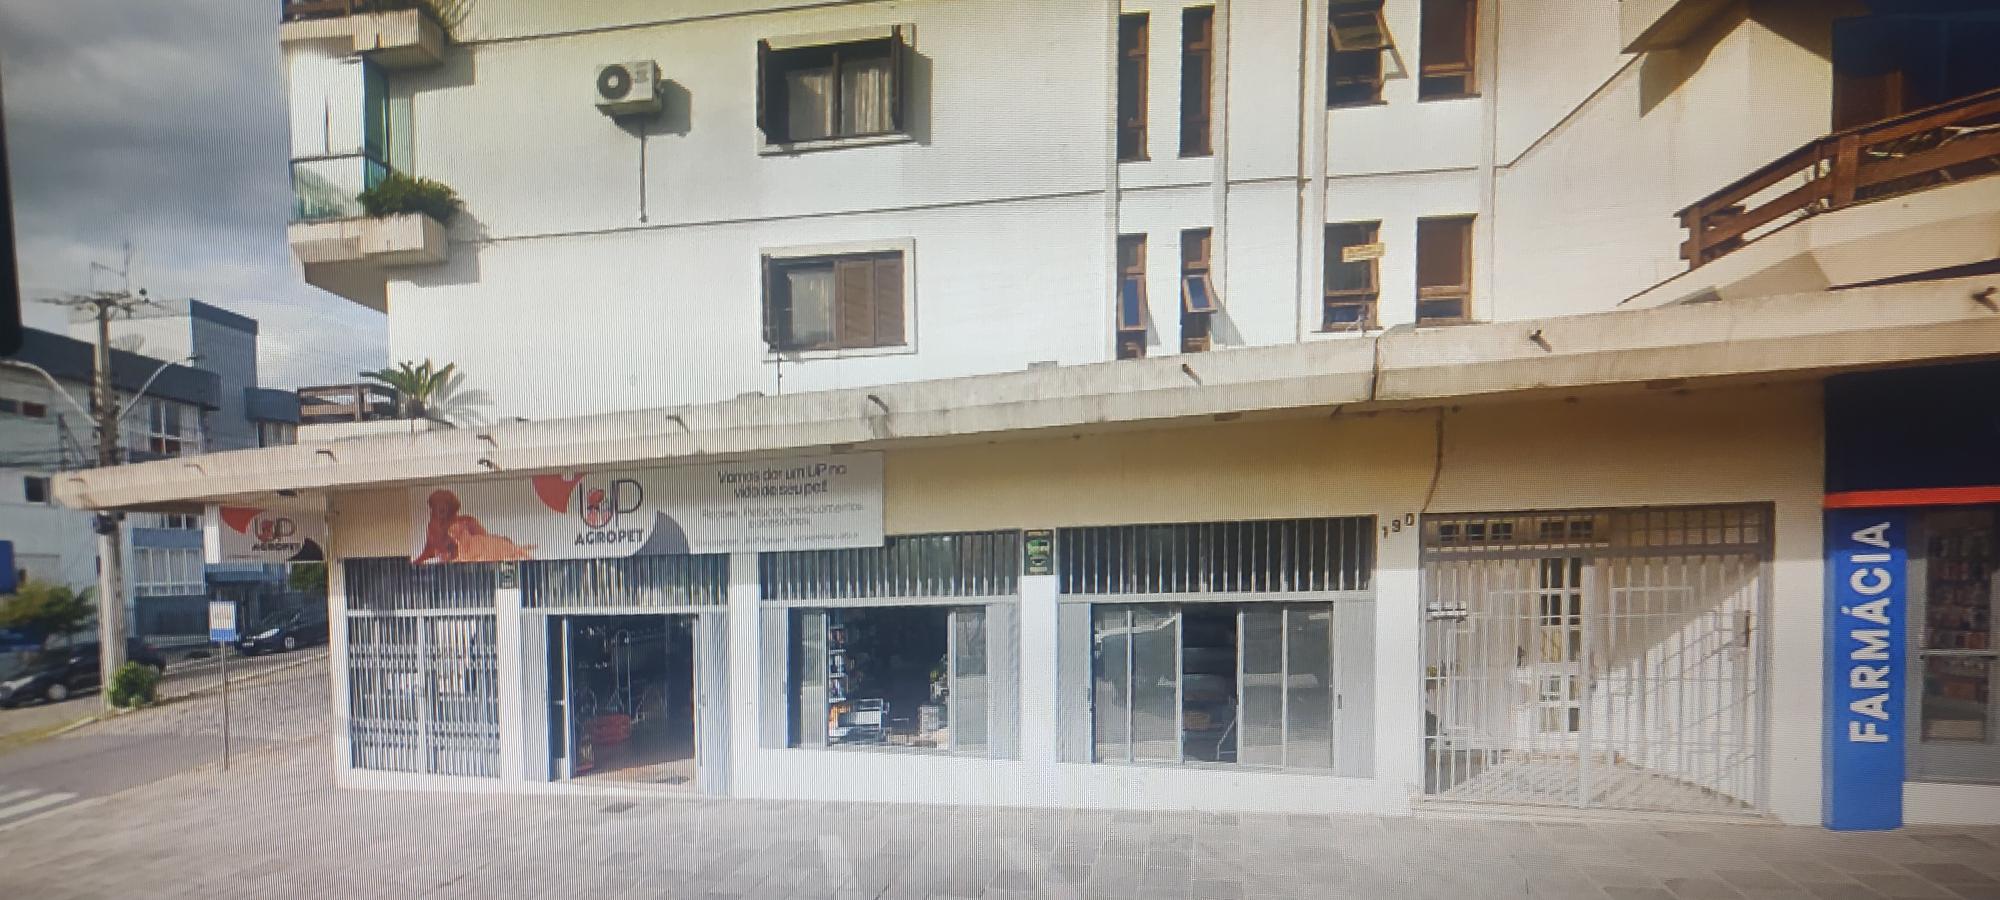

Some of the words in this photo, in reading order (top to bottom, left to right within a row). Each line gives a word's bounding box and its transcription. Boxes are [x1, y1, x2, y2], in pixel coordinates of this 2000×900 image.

[718, 469, 760, 484] Vamos
[763, 467, 782, 481] dar
[785, 467, 804, 480] um
[807, 463, 828, 477] UP
[734, 485, 759, 499] vida
[761, 484, 777, 497] de
[779, 483, 802, 496] seu
[1382, 512, 1415, 539] 190
[574, 528, 644, 546] AGROPET
[1841, 521, 1892, 743] FARMÁCIA
